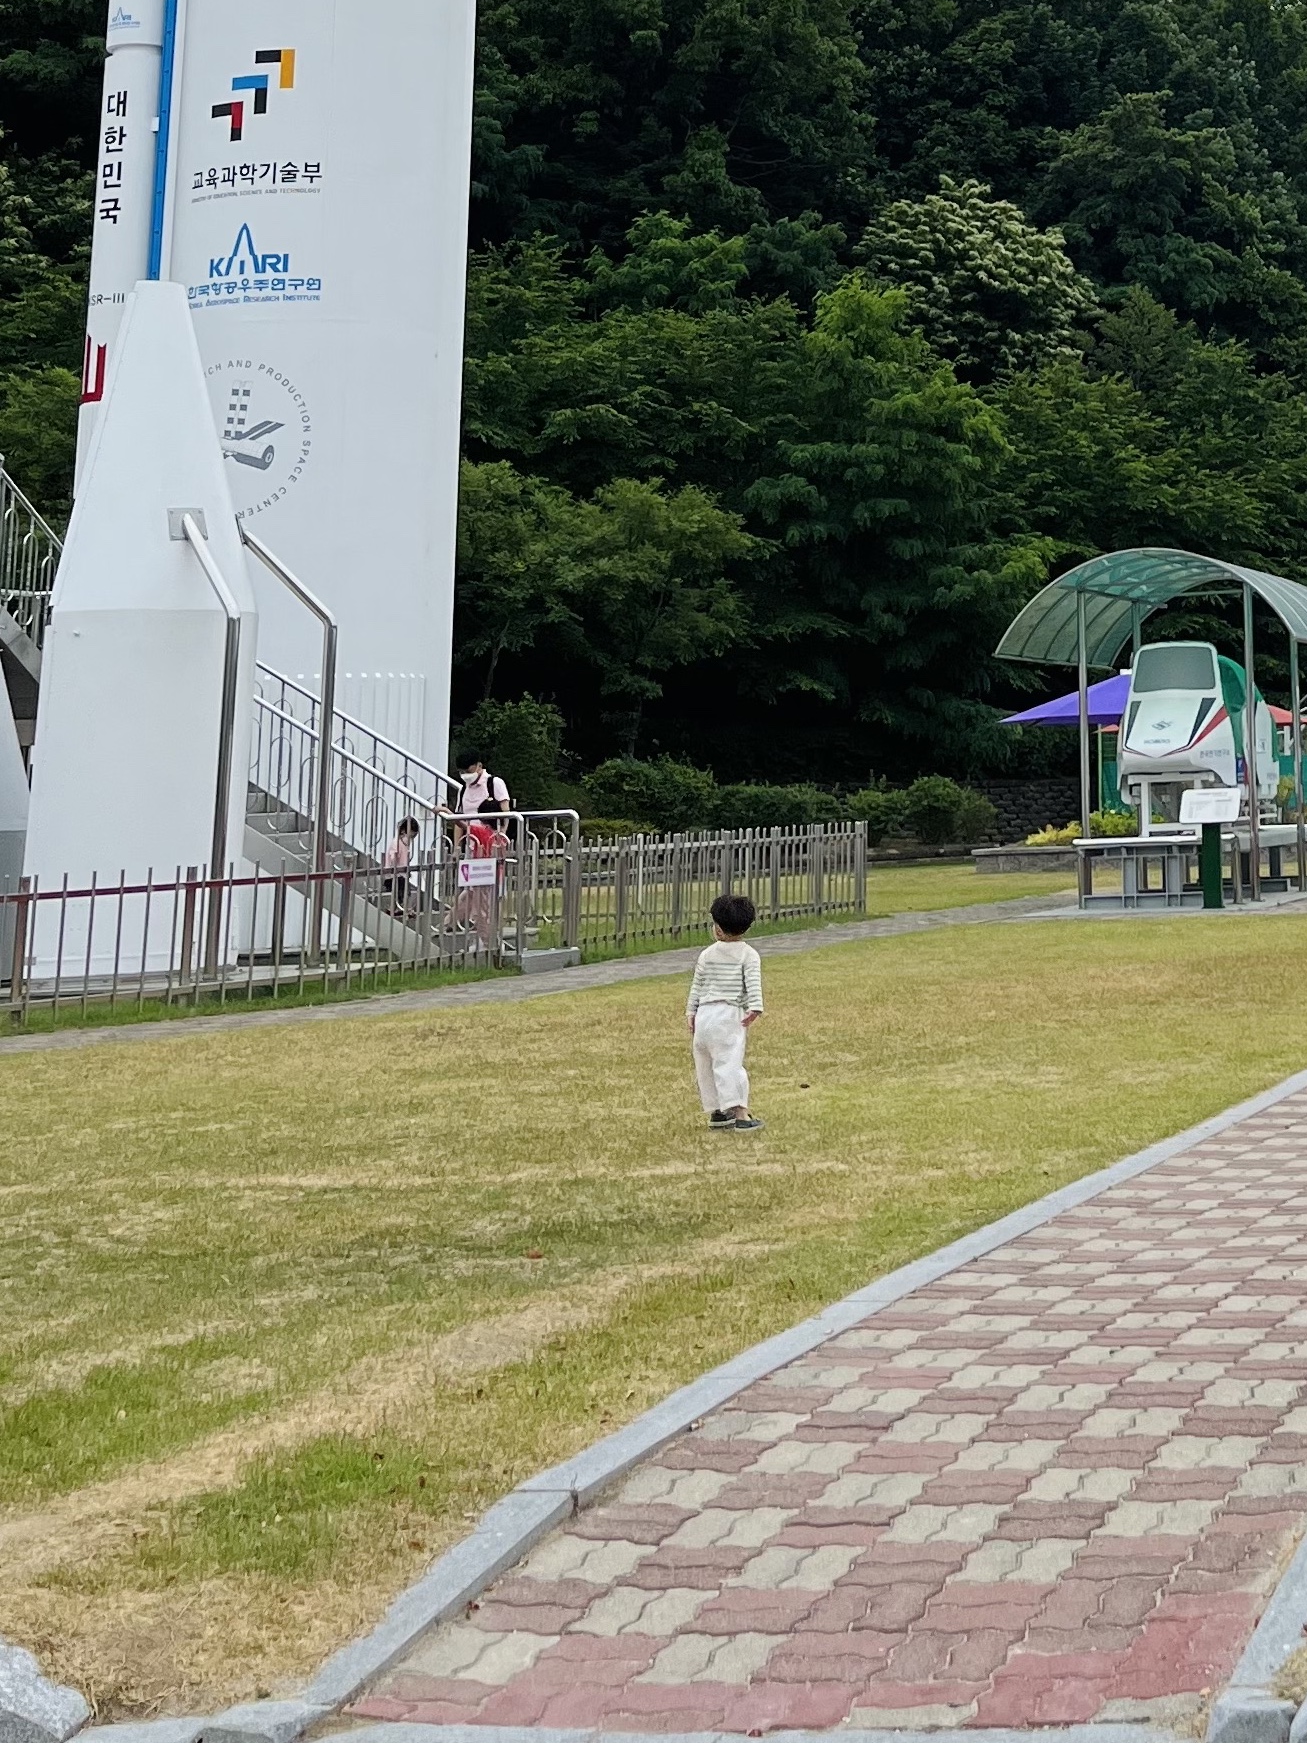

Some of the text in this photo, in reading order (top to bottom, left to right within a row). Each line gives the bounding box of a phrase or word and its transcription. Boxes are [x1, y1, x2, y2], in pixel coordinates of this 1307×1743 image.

[99, 90, 127, 224] 대한민국
[191, 161, 322, 190] 교육과학기술부
[209, 223, 289, 278] KARI
[227, 360, 252, 368] AND
[258, 363, 312, 433] PRODUCTION
[288, 440, 311, 483] SPACE
[237, 487, 287, 519] CENTER
